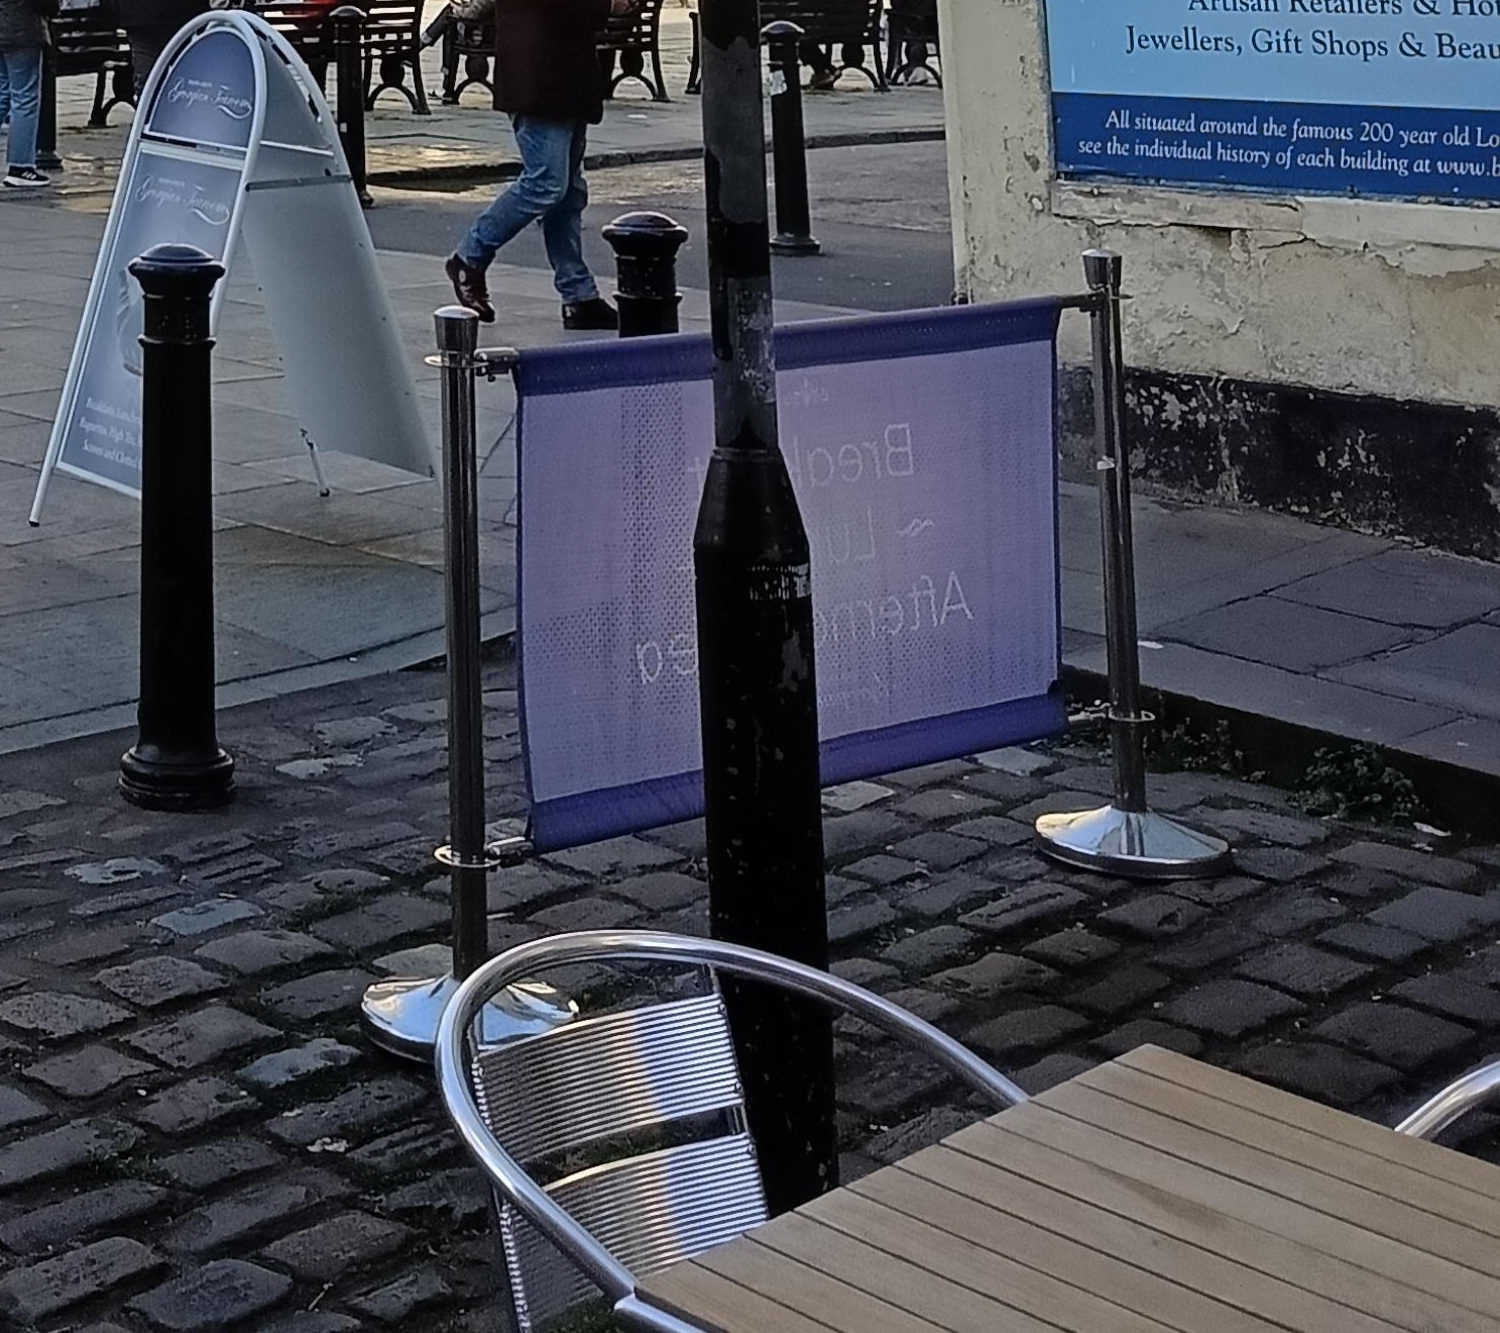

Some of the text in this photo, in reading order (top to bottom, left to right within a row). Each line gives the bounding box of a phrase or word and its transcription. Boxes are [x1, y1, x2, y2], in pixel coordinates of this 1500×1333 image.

[1125, 25, 1242, 55] Jewellers,
[1251, 27, 1303, 54] Gift
[1311, 30, 1389, 63] Shops
[1398, 31, 1426, 58] &
[1105, 109, 1130, 129] All
[1134, 113, 1195, 133] situated
[1200, 115, 1259, 136] around
[1263, 117, 1287, 137] the
[1290, 118, 1353, 144] famous
[1359, 121, 1394, 142] 200
[1398, 127, 1437, 148] year
[1442, 124, 1470, 146] old
[1078, 137, 1102, 154] see
[1106, 136, 1130, 156] the
[1134, 137, 1212, 160] individual
[1216, 140, 1271, 168] history
[1274, 145, 1293, 168] of
[1297, 146, 1335, 168] each
[1339, 147, 1409, 176] building
[1413, 155, 1432, 173] at
